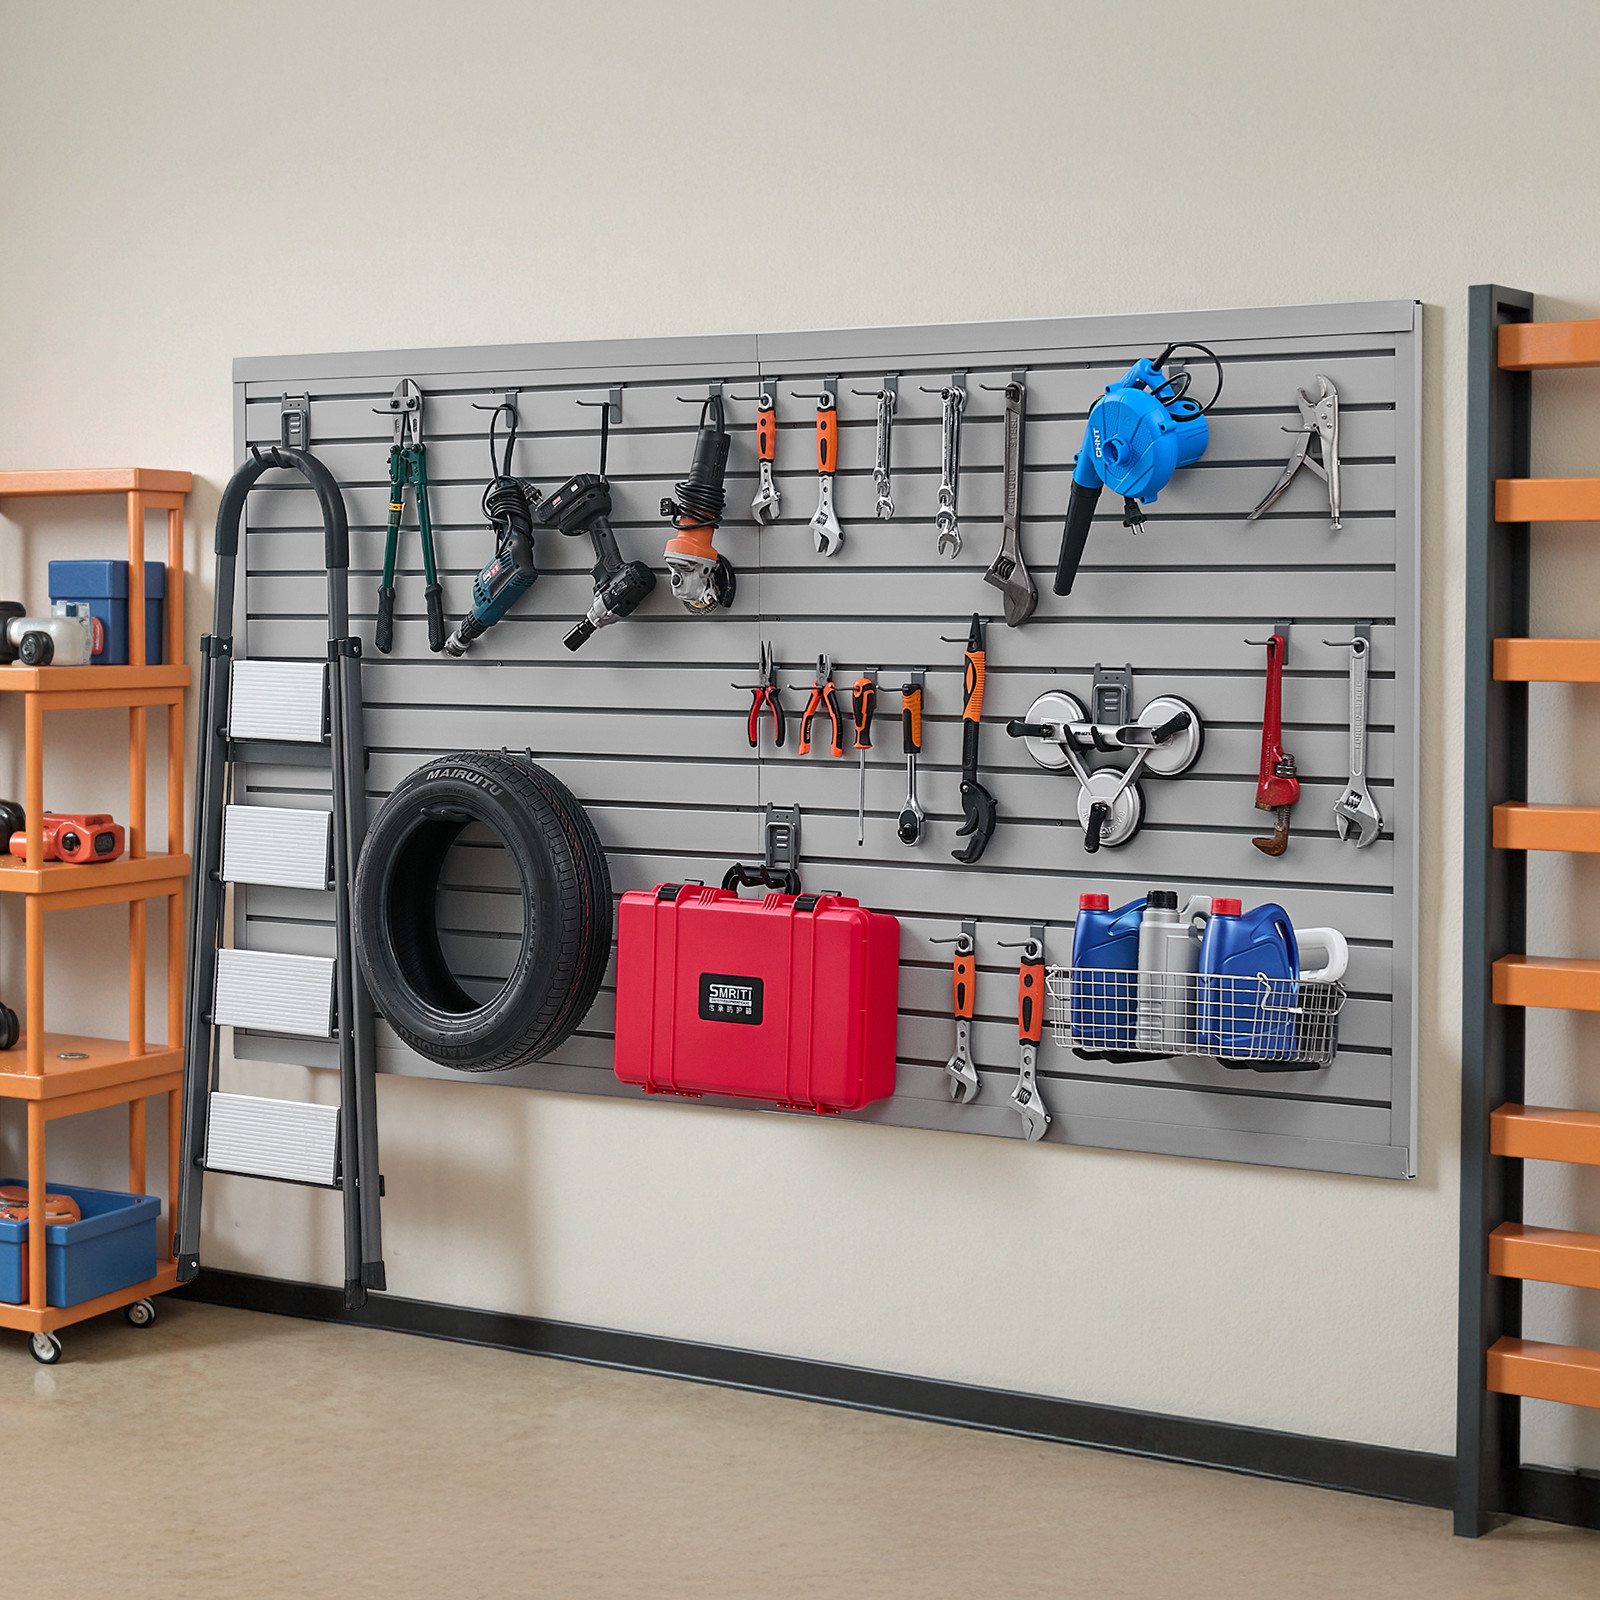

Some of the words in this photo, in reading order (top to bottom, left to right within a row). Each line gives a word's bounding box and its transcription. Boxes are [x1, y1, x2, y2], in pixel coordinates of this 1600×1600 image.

[1092, 427, 1103, 458] CHNT
[426, 768, 503, 796] MAIRUITU
[709, 983, 753, 1001] SMRITI
